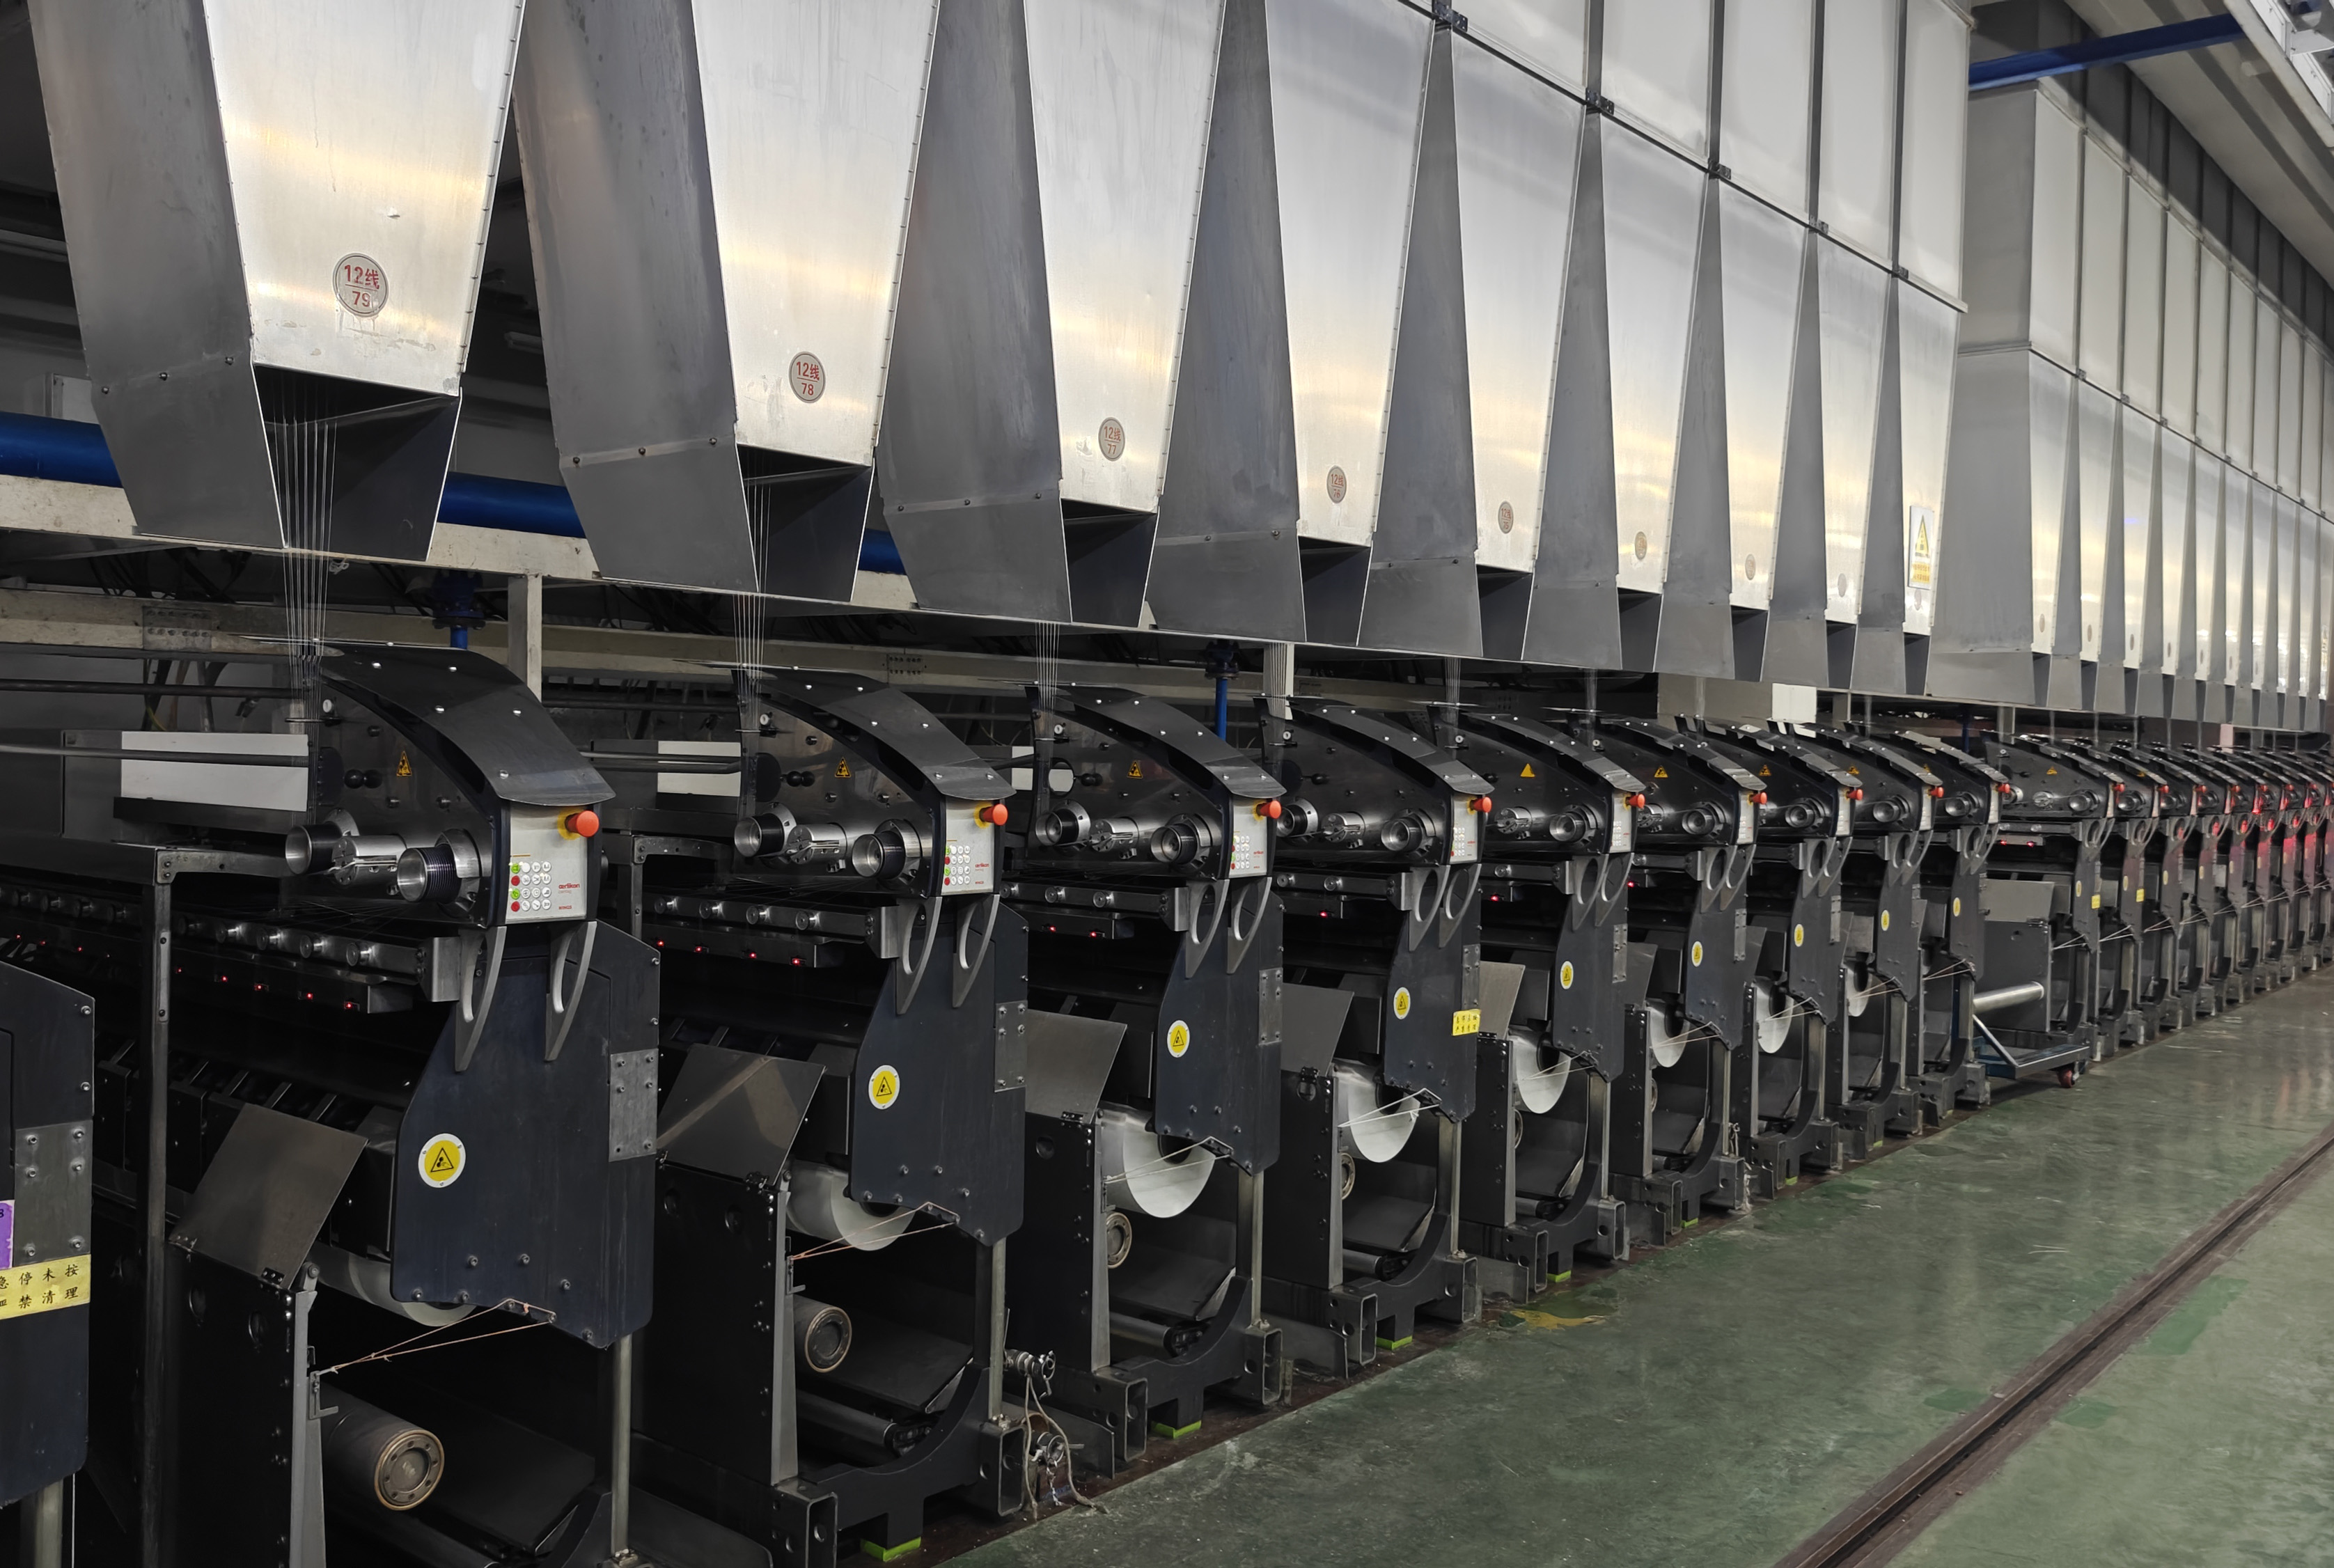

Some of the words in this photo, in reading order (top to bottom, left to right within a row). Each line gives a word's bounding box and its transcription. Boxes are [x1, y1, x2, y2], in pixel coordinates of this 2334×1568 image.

[344, 264, 380, 290] 12线
[352, 290, 371, 308] 79
[796, 361, 820, 381] 12线
[801, 382, 814, 396] 78
[1107, 444, 1117, 455] 77
